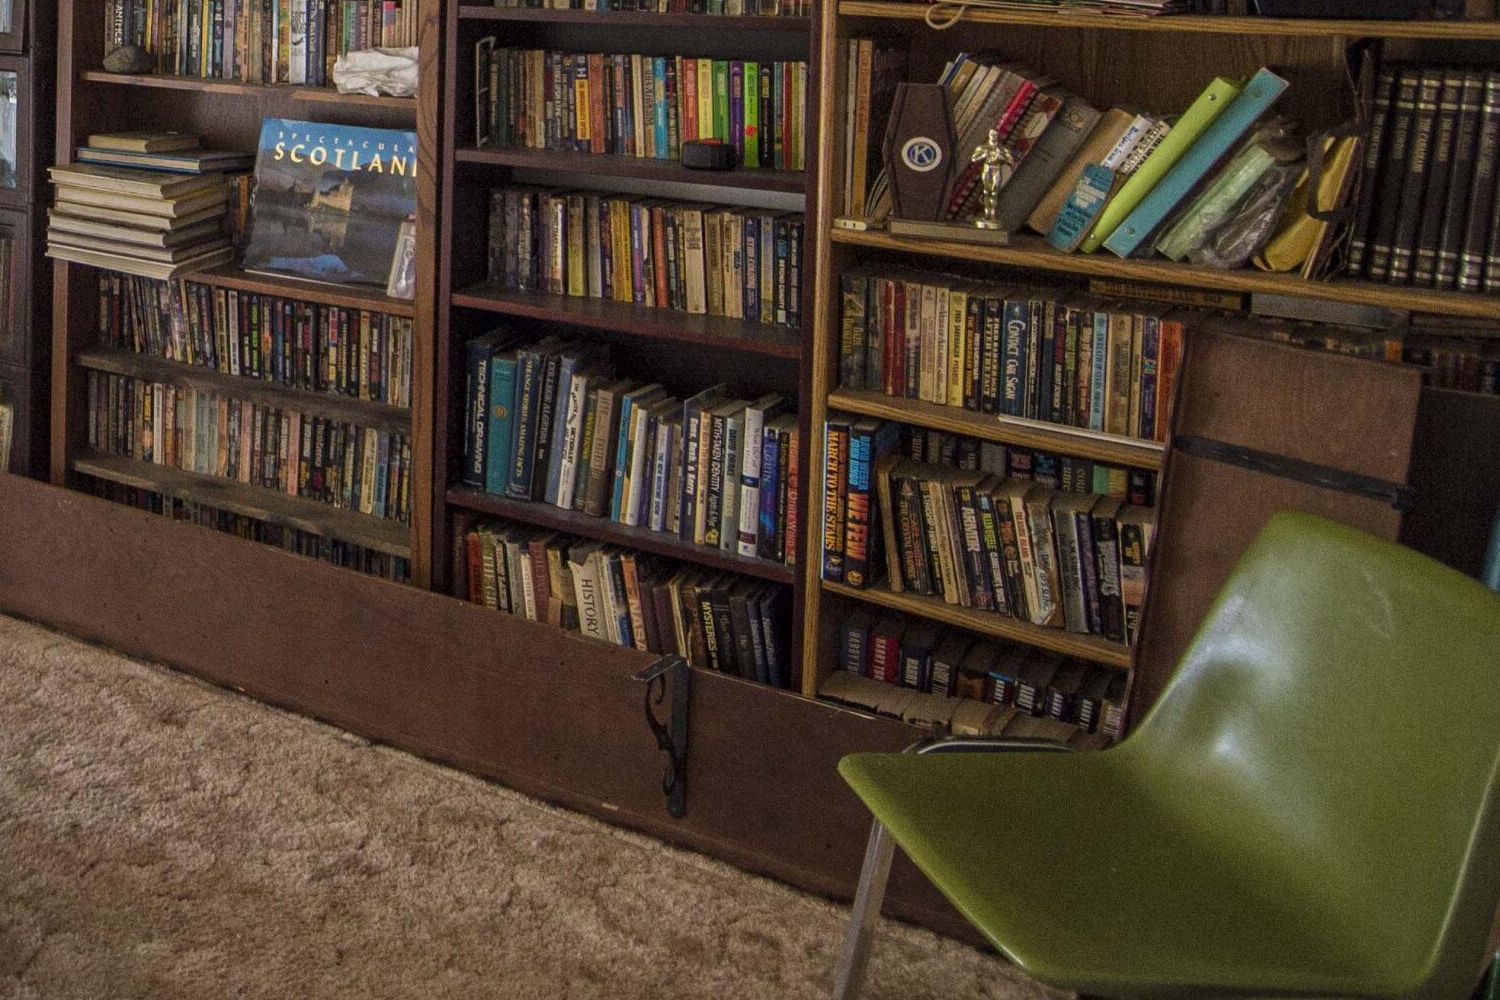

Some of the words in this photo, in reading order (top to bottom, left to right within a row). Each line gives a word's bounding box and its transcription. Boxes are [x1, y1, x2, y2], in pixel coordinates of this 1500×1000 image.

[278, 131, 415, 154] SPECTACULA
[1007, 319, 1026, 355] CONTACT
[476, 360, 487, 420] TECHNICAL
[544, 361, 556, 403] COLLEGE
[1005, 376, 1018, 400] SAGAN
[517, 423, 527, 456] AMAZING
[540, 403, 552, 445] ALGEBRA
[474, 421, 484, 474] DRAWING
[827, 431, 839, 471] MARCH
[850, 438, 860, 458] JOHN
[860, 436, 870, 460] DAVID
[710, 461, 721, 492] IDENTITY
[826, 473, 838, 488] TO
[849, 459, 860, 486] RINGO
[826, 490, 837, 513] THE
[848, 493, 869, 520] WE
[825, 514, 837, 550] STARS
[847, 521, 868, 561] FEW
[961, 505, 980, 552] ARMOR
[581, 578, 599, 635] HISTORY
[629, 599, 646, 652] NASA
[702, 601, 718, 652] MYSTERIES
[904, 657, 919, 685] HARRY
